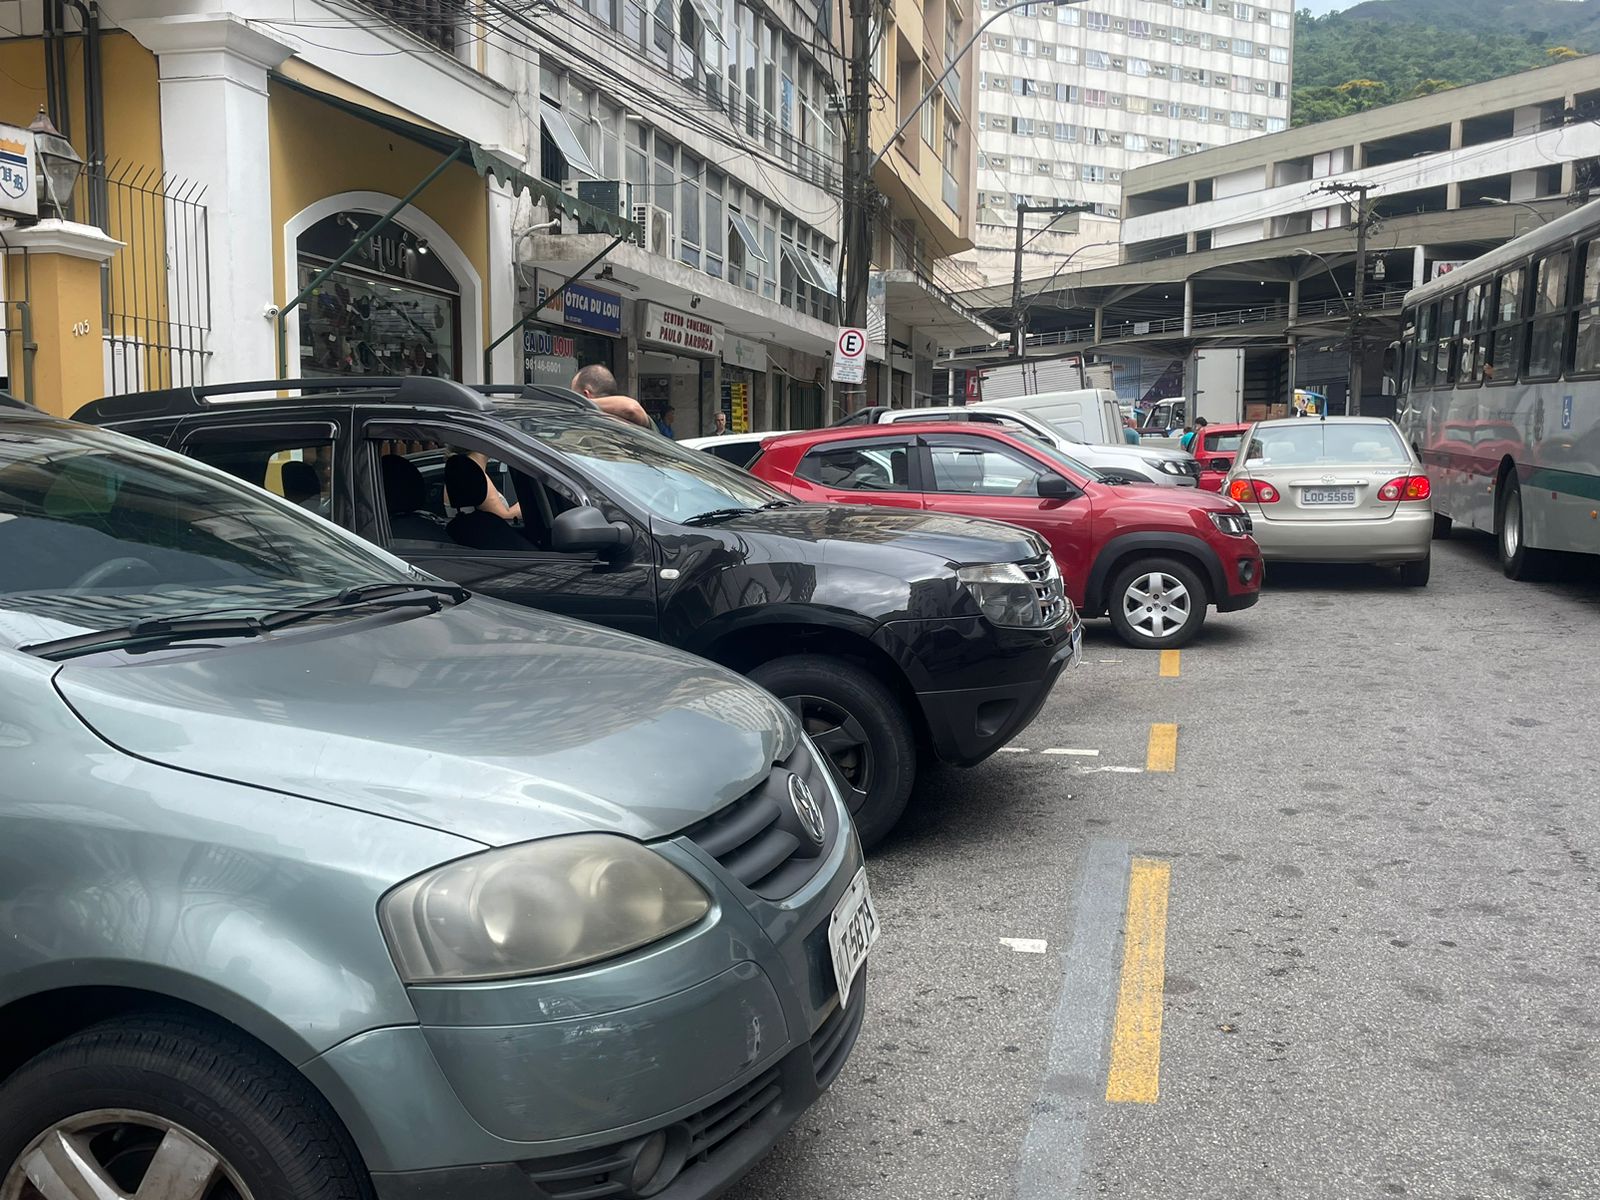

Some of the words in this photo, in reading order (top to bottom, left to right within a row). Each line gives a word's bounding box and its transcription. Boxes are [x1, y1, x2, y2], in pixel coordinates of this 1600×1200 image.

[565, 288, 589, 312] ÓTICA
[590, 298, 602, 315] DU
[602, 302, 620, 319] LOUI
[72, 319, 90, 337] 105
[663, 311, 684, 327] CENTRO
[538, 334, 552, 355] DU
[553, 335, 574, 359] LOUI
[659, 326, 682, 344] PAULO
[684, 332, 713, 352] BARBOSA
[846, 335, 857, 352] E
